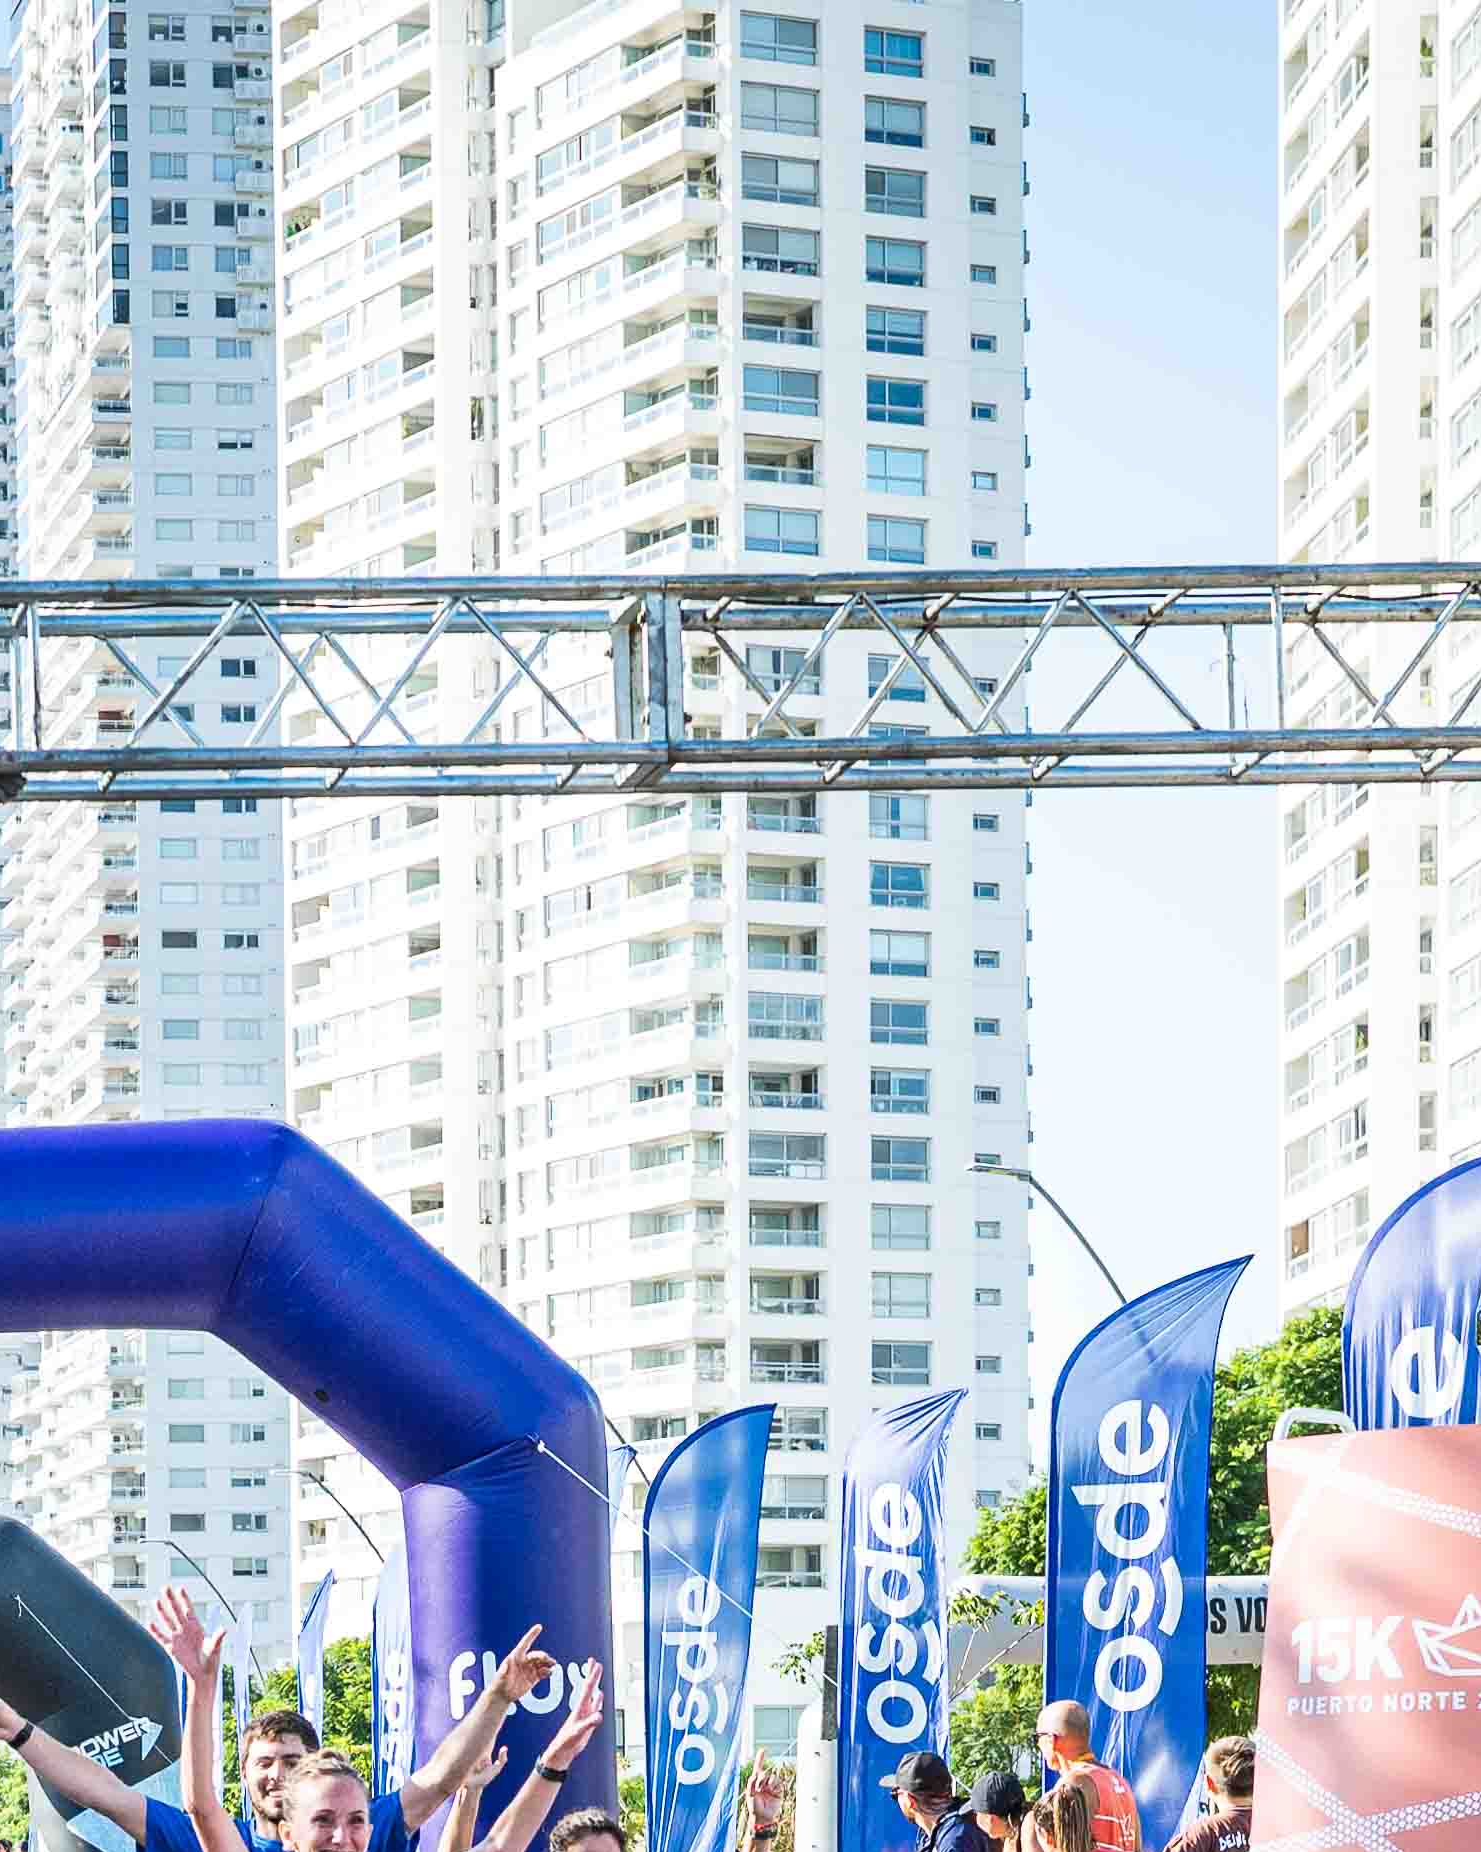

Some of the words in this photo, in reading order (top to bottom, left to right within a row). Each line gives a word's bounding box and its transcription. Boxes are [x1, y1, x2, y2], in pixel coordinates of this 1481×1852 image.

[854, 1481, 942, 1744] osde
[1072, 1399, 1184, 1713] osde
[1291, 1615, 1405, 1685] 15K
[661, 1578, 728, 1786] osde
[1287, 1695, 1373, 1716] PUERTO
[1385, 1690, 1468, 1713] NORTE
